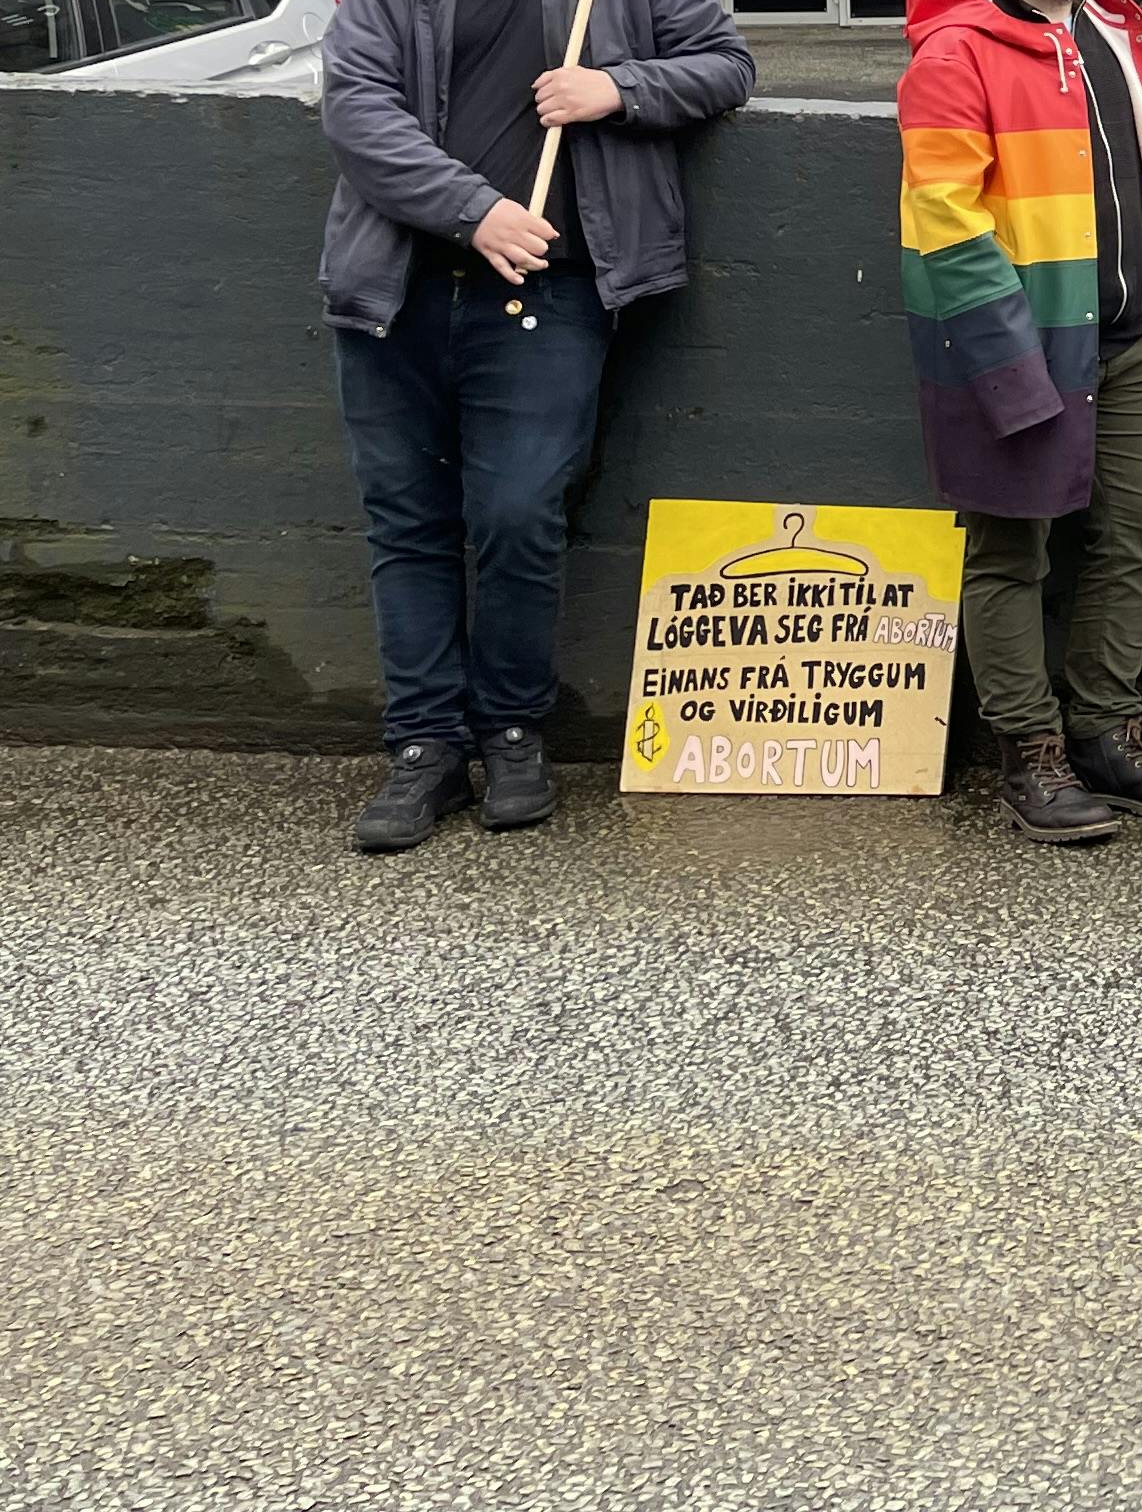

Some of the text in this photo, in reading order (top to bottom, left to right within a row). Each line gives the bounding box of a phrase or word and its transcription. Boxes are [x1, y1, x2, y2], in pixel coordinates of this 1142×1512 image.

[670, 583, 726, 611] TAÐ
[732, 583, 777, 608] BER
[881, 583, 914, 608] AT
[773, 614, 824, 644] SEG
[831, 606, 871, 642] FRÁ
[739, 655, 790, 690] FRÁ
[801, 660, 926, 690] TRYGGUM
[680, 699, 717, 722] OG
[672, 735, 881, 789] ABORTUM
